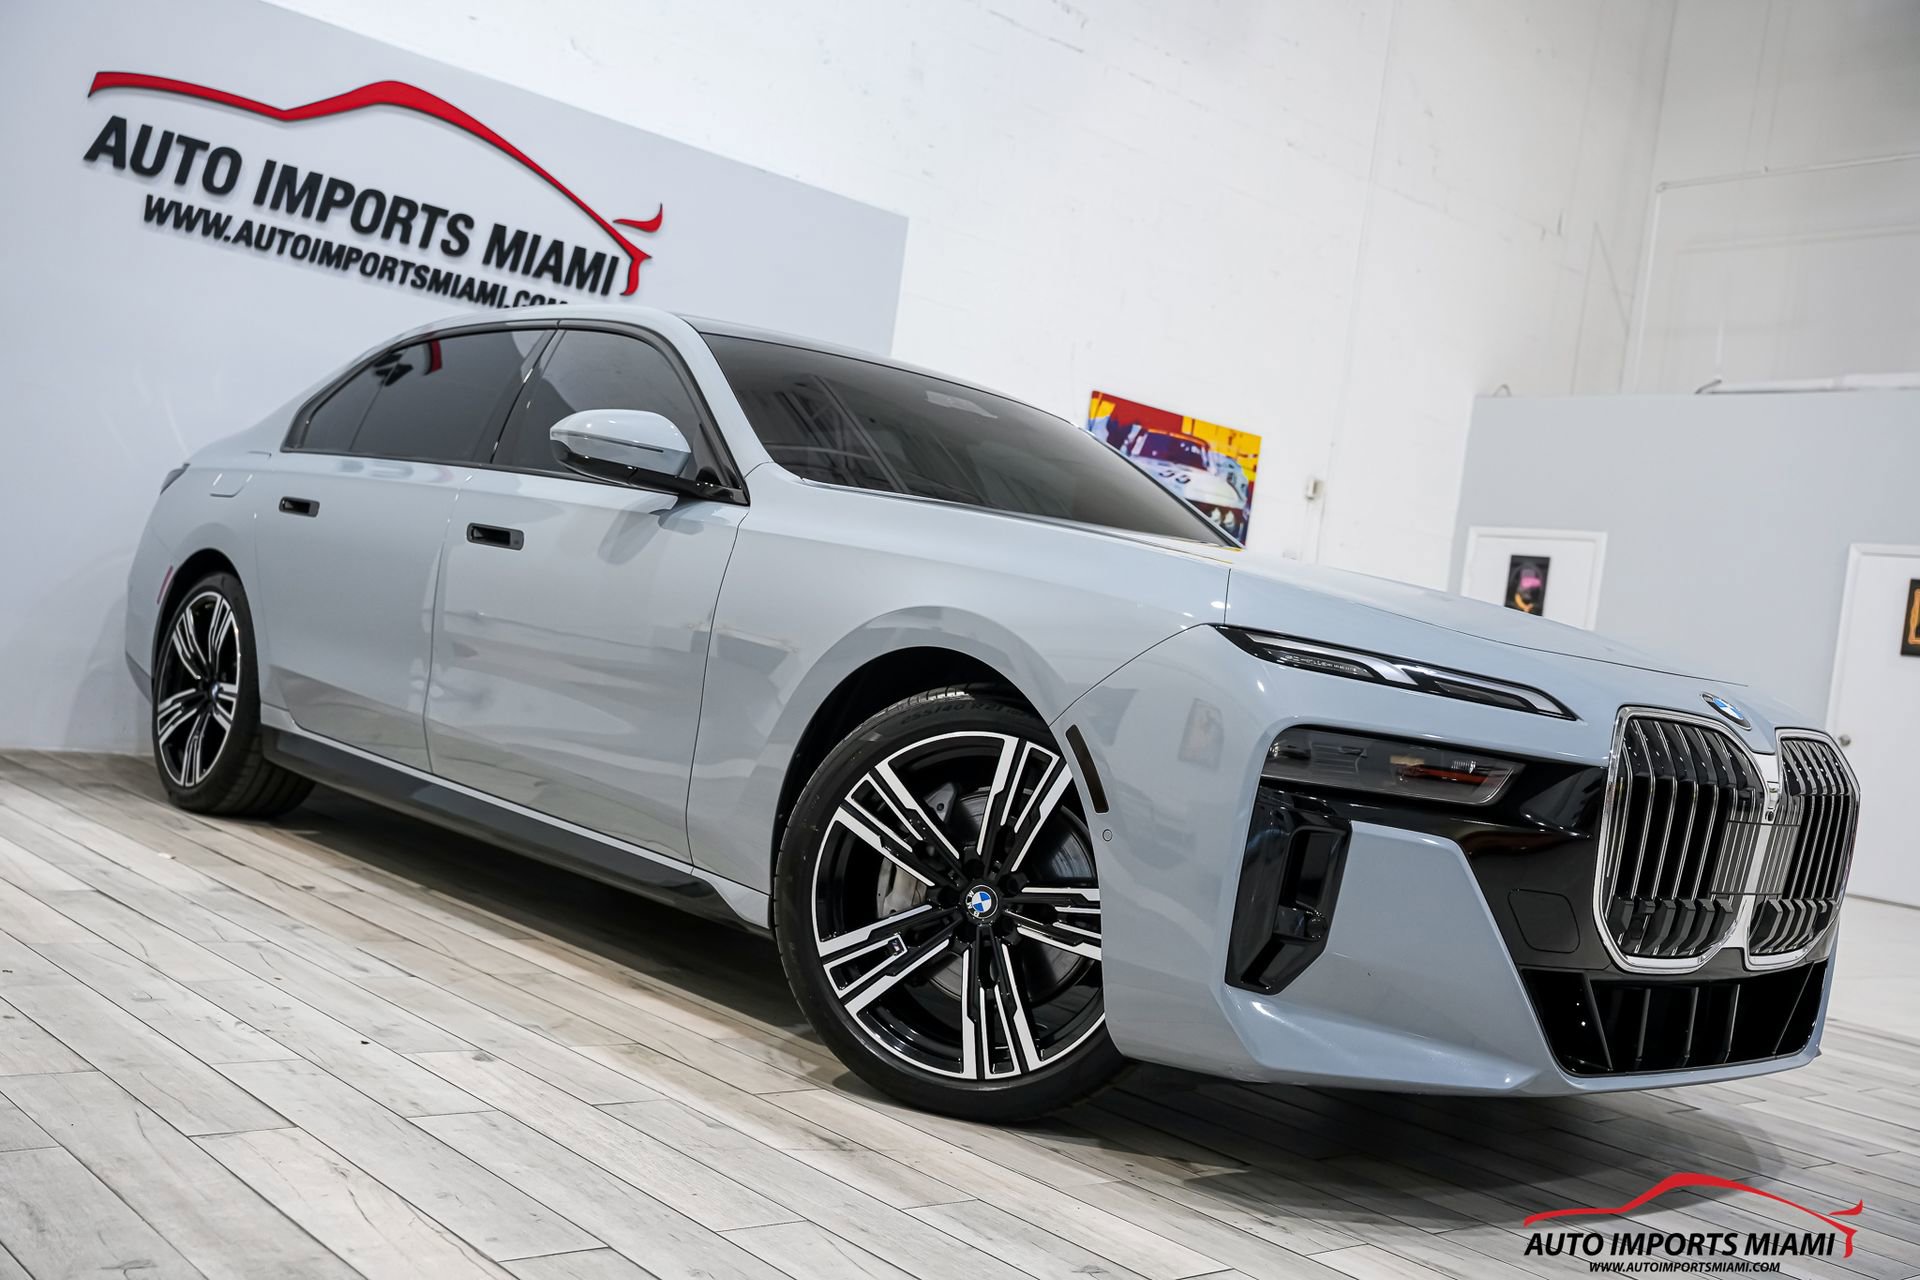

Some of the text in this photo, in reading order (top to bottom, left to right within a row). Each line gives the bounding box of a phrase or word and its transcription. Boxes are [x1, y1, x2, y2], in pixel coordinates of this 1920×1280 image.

[83, 115, 620, 297] AUTO IMPORTS MIAMI
[143, 194, 568, 309] WWW.AUTOIMPORTSMIAMI.C
